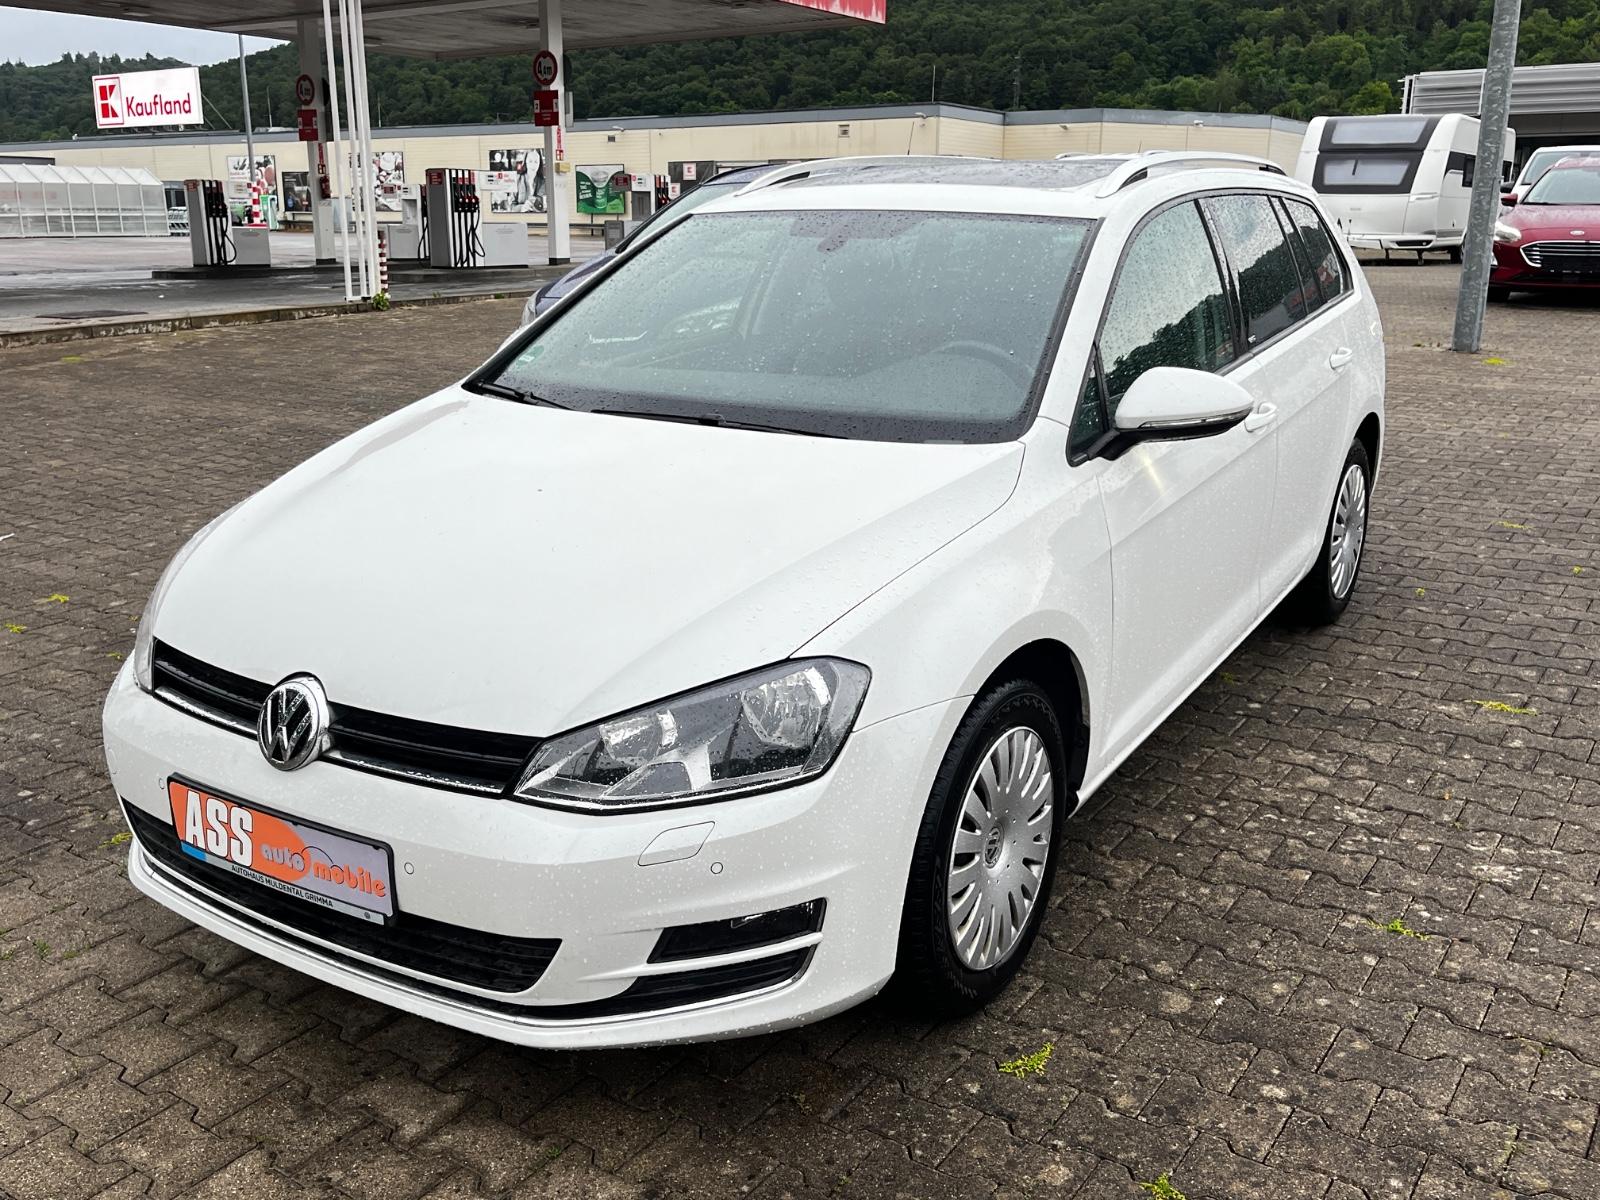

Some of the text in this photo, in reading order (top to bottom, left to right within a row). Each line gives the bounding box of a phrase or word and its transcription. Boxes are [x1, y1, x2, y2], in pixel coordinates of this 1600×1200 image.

[126, 92, 192, 117] Kaufland
[185, 789, 253, 867] ASS
[231, 864, 334, 908] AUTOHAUS MULDENTAL GRIMMA
[261, 843, 386, 897] auto mobile
